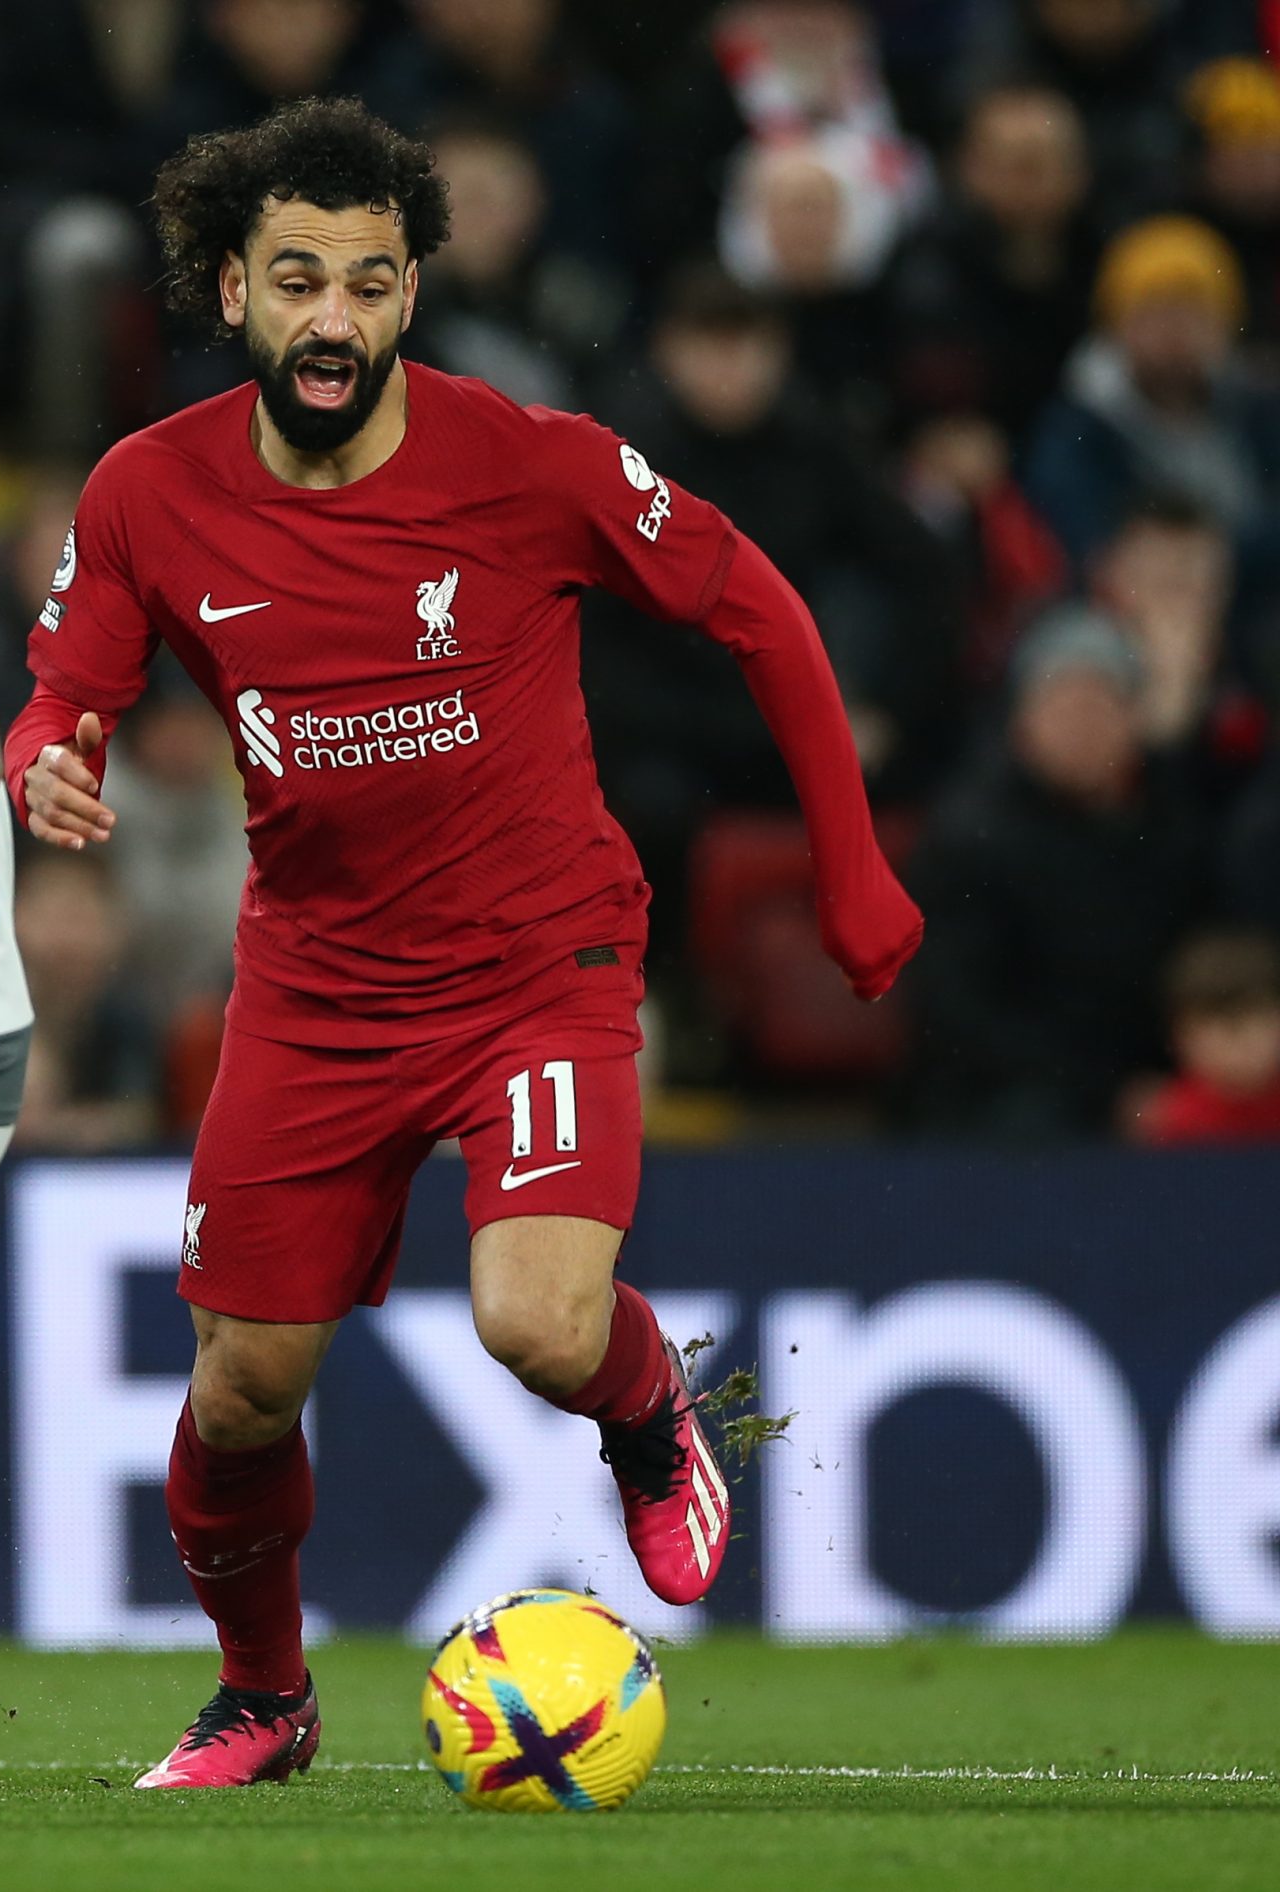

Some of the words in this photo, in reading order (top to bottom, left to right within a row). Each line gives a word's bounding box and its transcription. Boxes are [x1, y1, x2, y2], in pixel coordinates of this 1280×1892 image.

[290, 689, 465, 741] standard
[293, 711, 480, 769] chartered
[506, 1060, 577, 1158] 11
